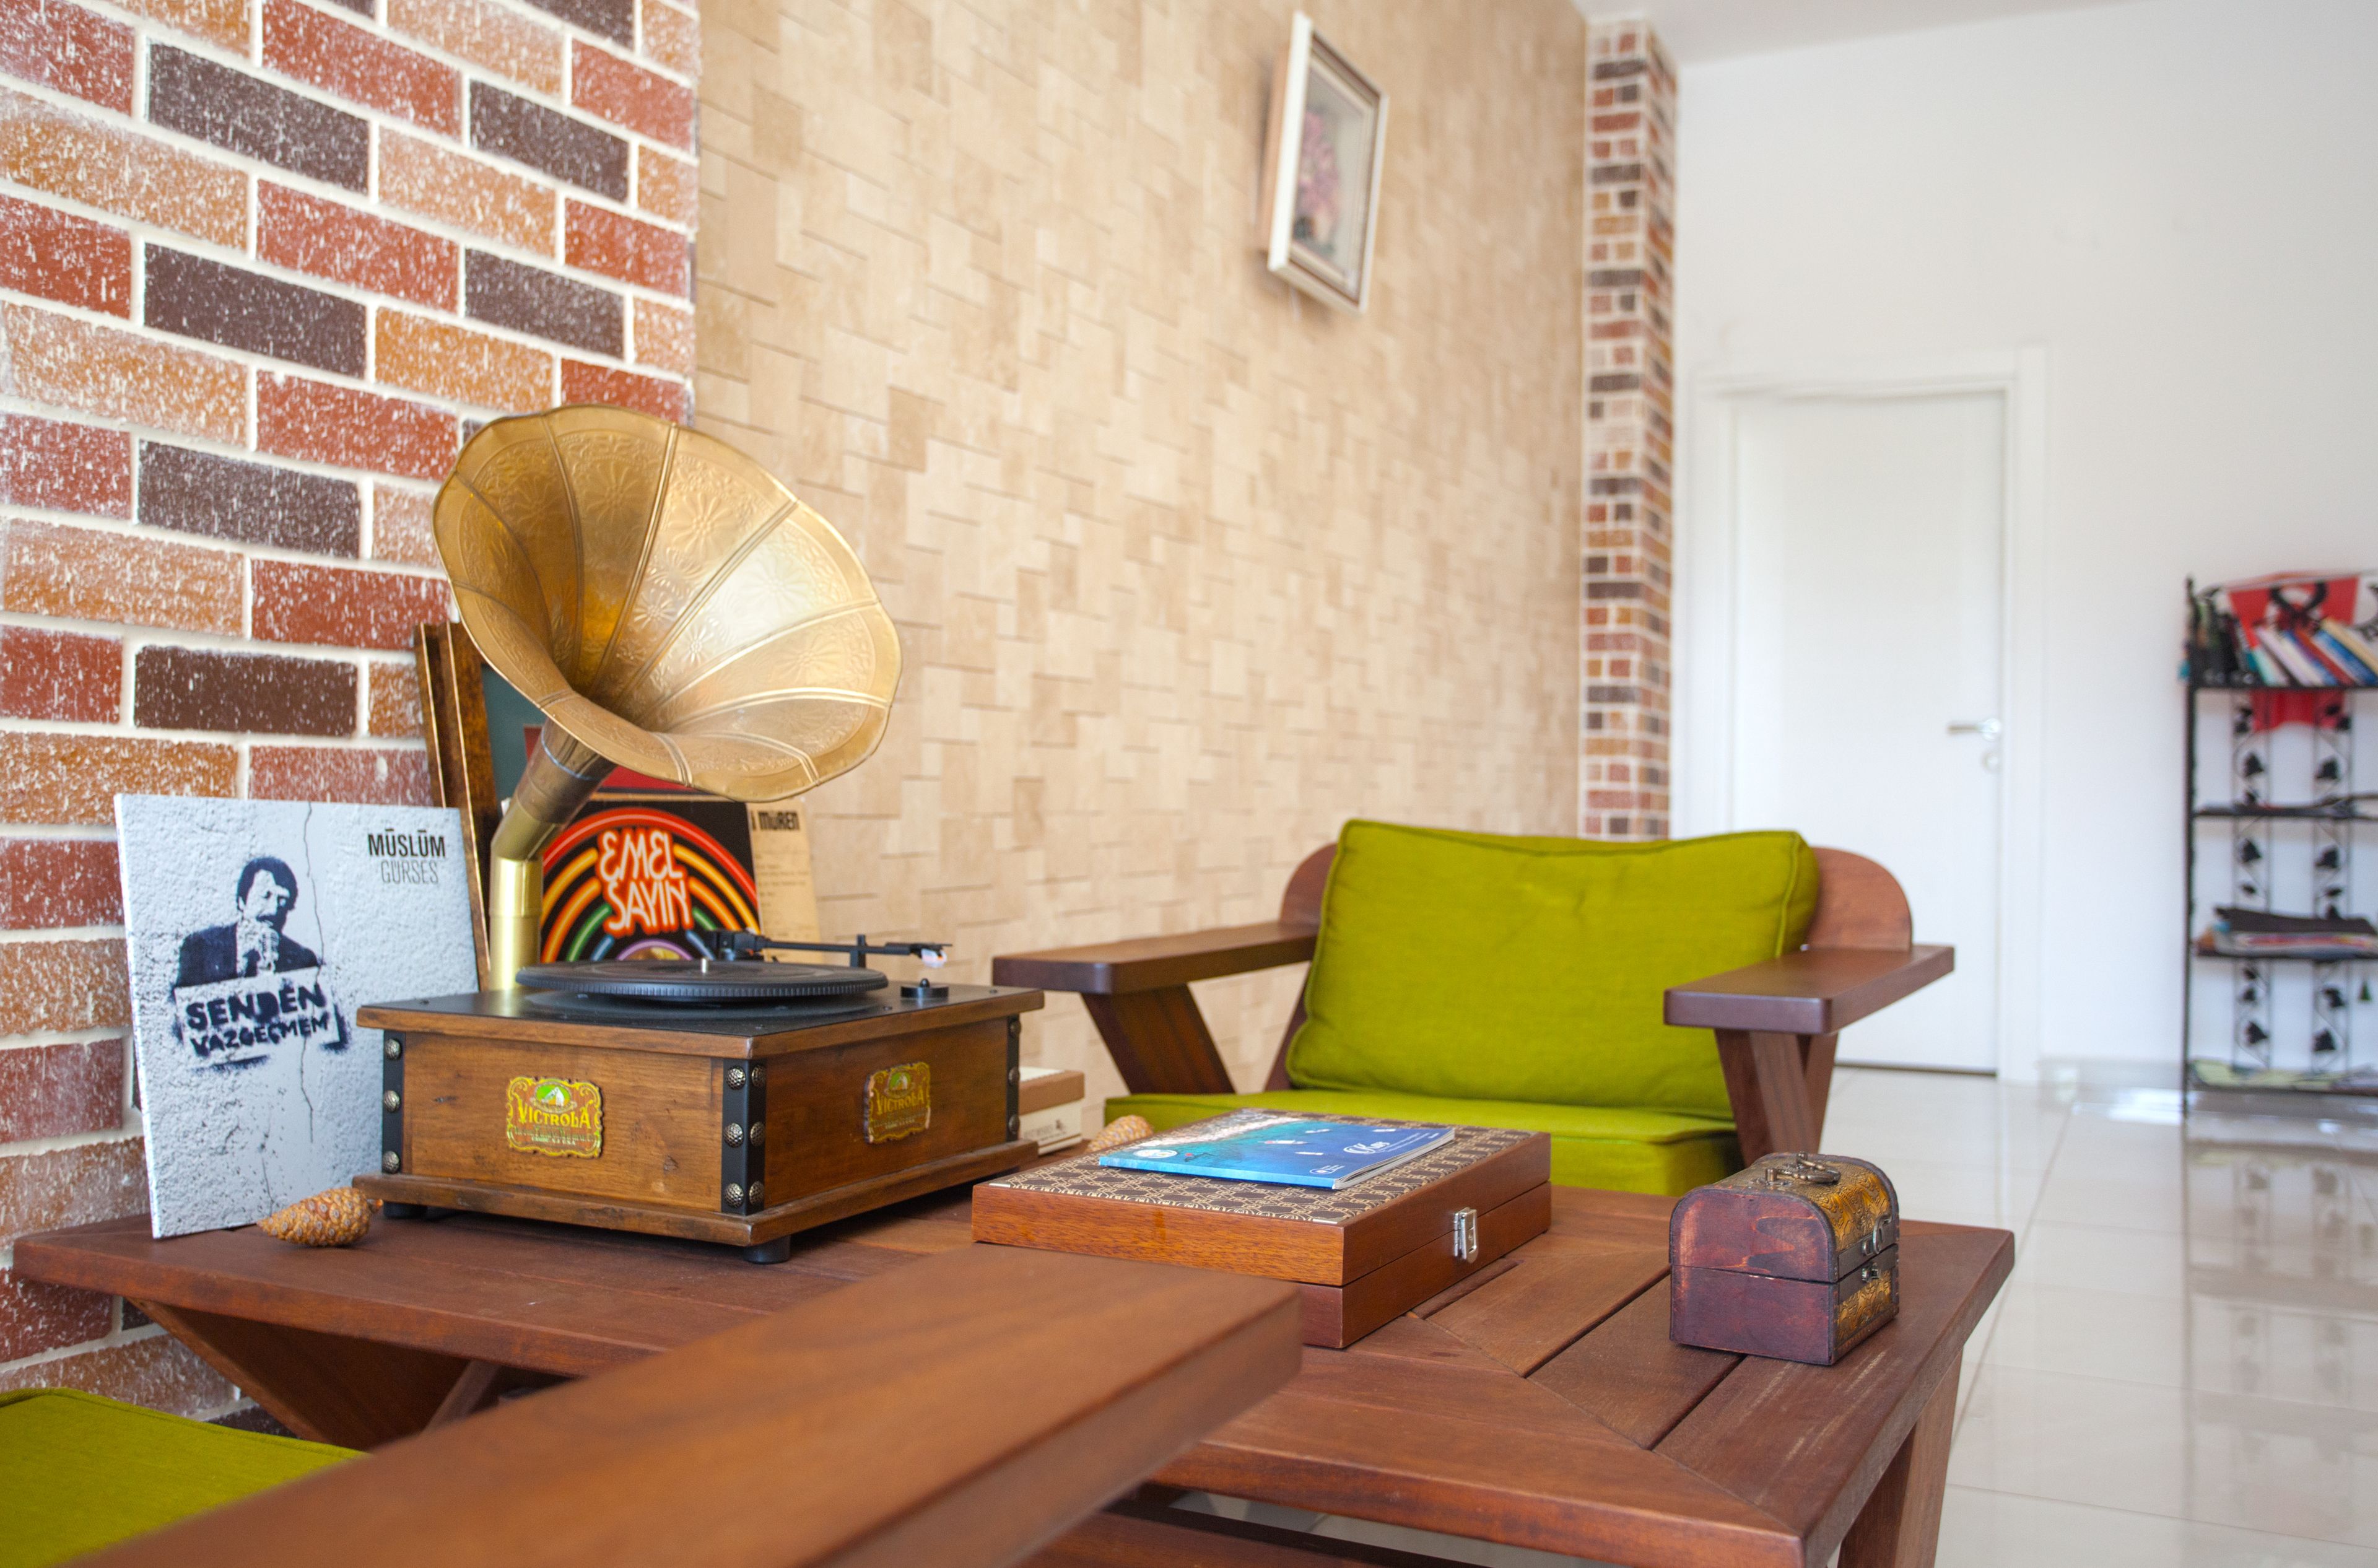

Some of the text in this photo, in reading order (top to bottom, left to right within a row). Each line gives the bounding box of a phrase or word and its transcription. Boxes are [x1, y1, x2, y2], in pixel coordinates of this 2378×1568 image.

[599, 829, 684, 882] EMEL
[607, 879, 691, 931] SAYIN
[186, 980, 327, 1031] SENDEN
[516, 1099, 592, 1129] VICTROLA
